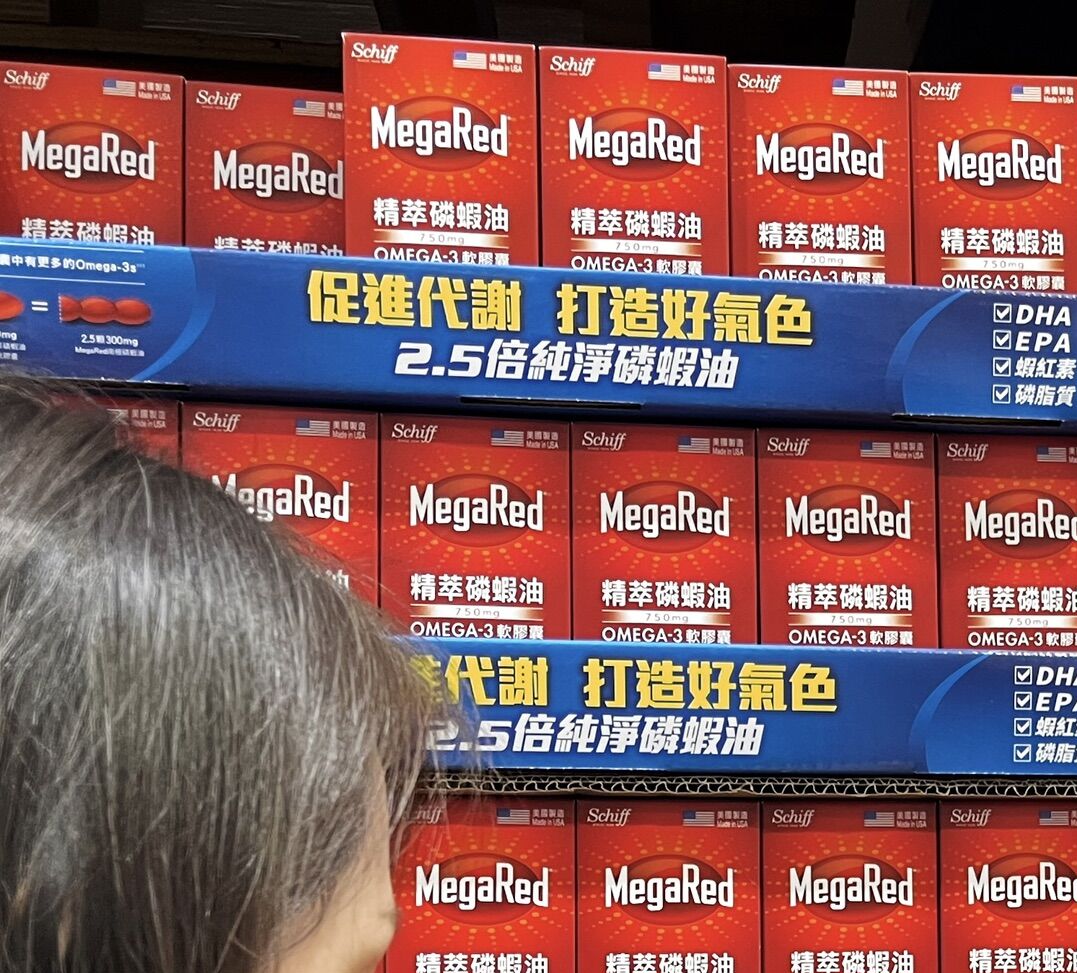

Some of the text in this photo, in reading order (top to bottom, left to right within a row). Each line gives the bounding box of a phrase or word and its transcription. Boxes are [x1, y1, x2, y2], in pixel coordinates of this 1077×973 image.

[351, 43, 398, 63] Schiff
[4, 71, 49, 90] Schiff
[372, 106, 507, 156] MegaRed
[570, 117, 700, 165] MegaRed
[22, 130, 154, 180] MegaRed
[215, 150, 343, 199] MegaRed
[757, 133, 883, 179] MegaRed
[939, 139, 1061, 185] MegaRed
[571, 207, 701, 239] 精萃磷蝦油
[941, 227, 1063, 255] 精萃磷蝦油
[942, 274, 1065, 290] OMEGA-3 軟膠囊
[308, 270, 813, 349] 促進代謝 打造好氣色
[1016, 305, 1071, 326] DHA
[395, 336, 742, 388] 2.5倍純淨磷蝦油
[1015, 332, 1070, 353] EPA
[1014, 356, 1076, 379] 蝦紅素
[1015, 384, 1076, 406] 磷脂質
[582, 432, 626, 450] Schiff
[411, 484, 543, 531] MegaRed
[601, 491, 729, 537] MegaRed
[786, 495, 910, 541] MegaRed
[411, 573, 542, 604] 精萃磷蝦油
[602, 627, 731, 644] OMEGA-3 軟膠囊
[645, 612, 689, 624] 750mg
[583, 659, 837, 711] 打造好氣色
[417, 863, 548, 909] MegaRed
[606, 864, 733, 910] MegaRed
[790, 864, 913, 909] MegaRed
